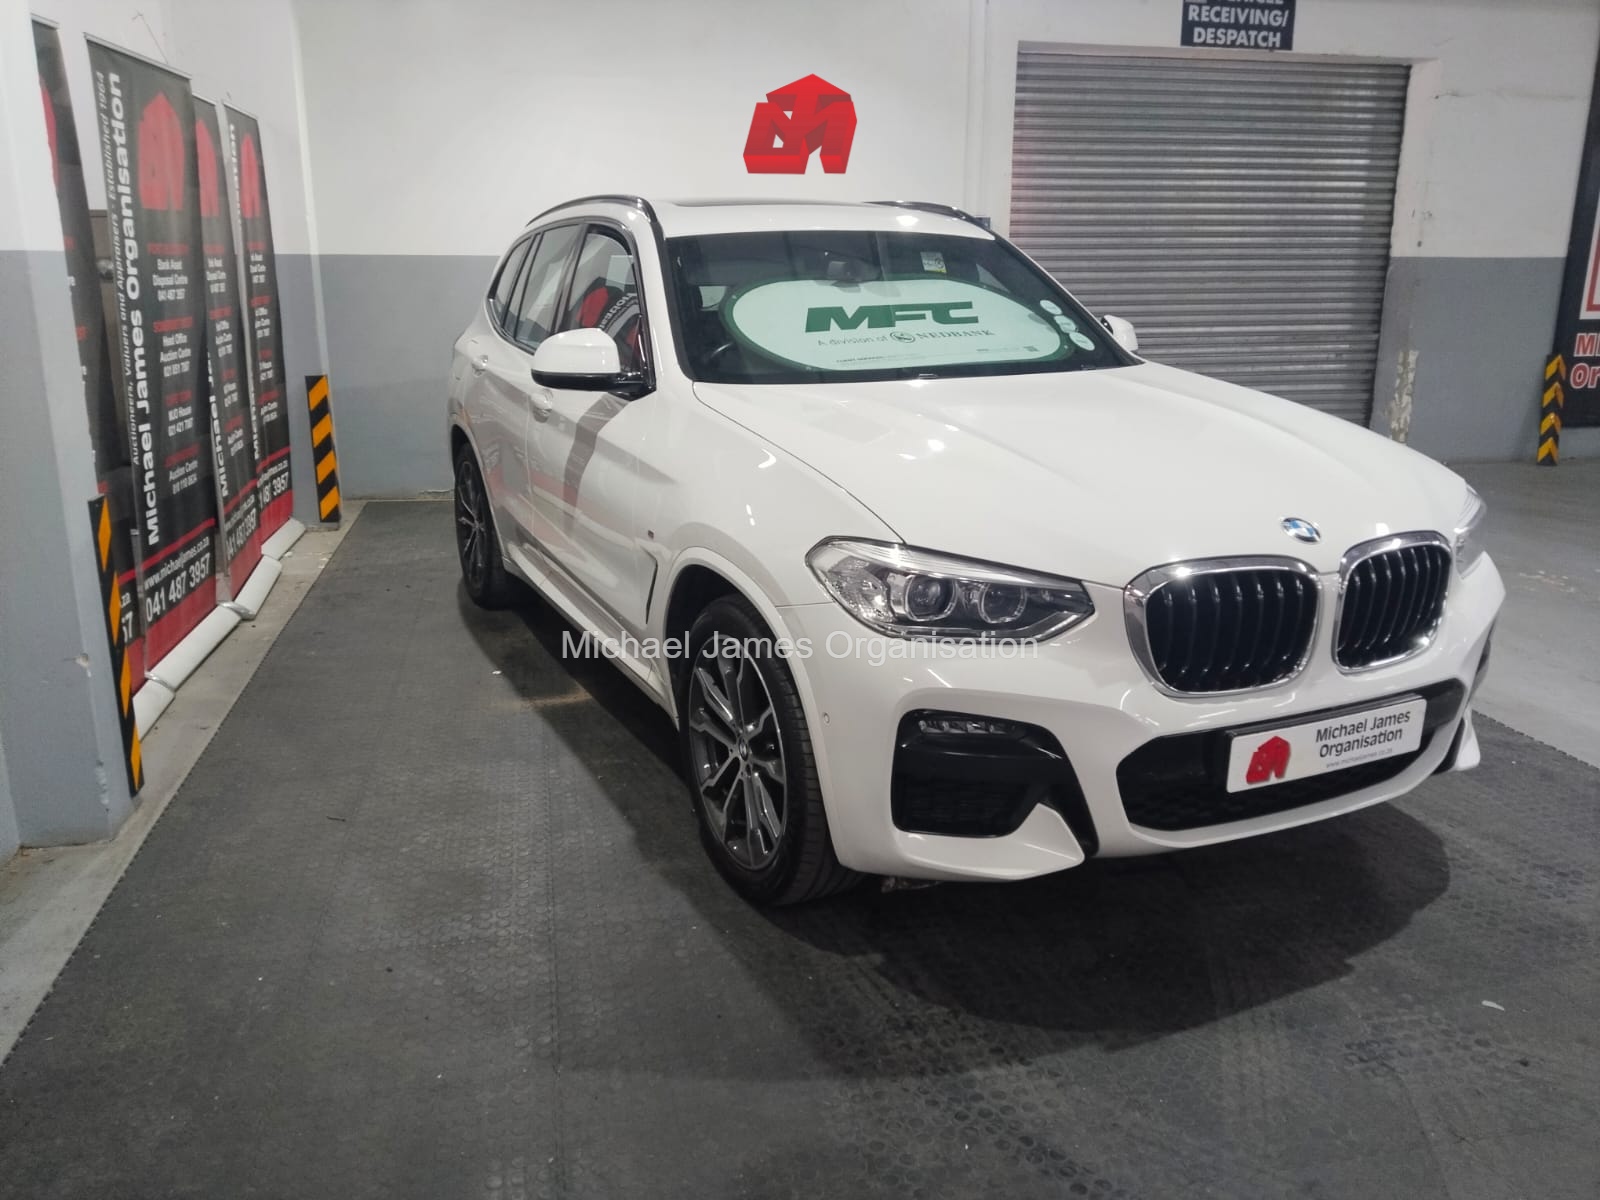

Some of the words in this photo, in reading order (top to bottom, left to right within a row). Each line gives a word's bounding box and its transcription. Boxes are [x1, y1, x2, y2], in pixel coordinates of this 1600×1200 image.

[1188, 4, 1289, 27] RECEIVING/
[1193, 27, 1281, 48] DESPATCH
[100, 113, 116, 201] Established
[109, 72, 140, 300] Organisation
[117, 292, 127, 321] and
[805, 301, 979, 333] MFC
[121, 325, 132, 376] Valuers
[829, 335, 872, 345] division
[916, 329, 996, 340] NEDBANK
[130, 309, 150, 415] James
[138, 422, 160, 546] Michael
[272, 471, 289, 497] 3957
[145, 586, 165, 622] 041
[168, 570, 187, 603] 487
[189, 552, 210, 588] 3957
[1315, 718, 1368, 743] Michael
[1370, 711, 1411, 731] James
[1319, 728, 1403, 758] Organisation
